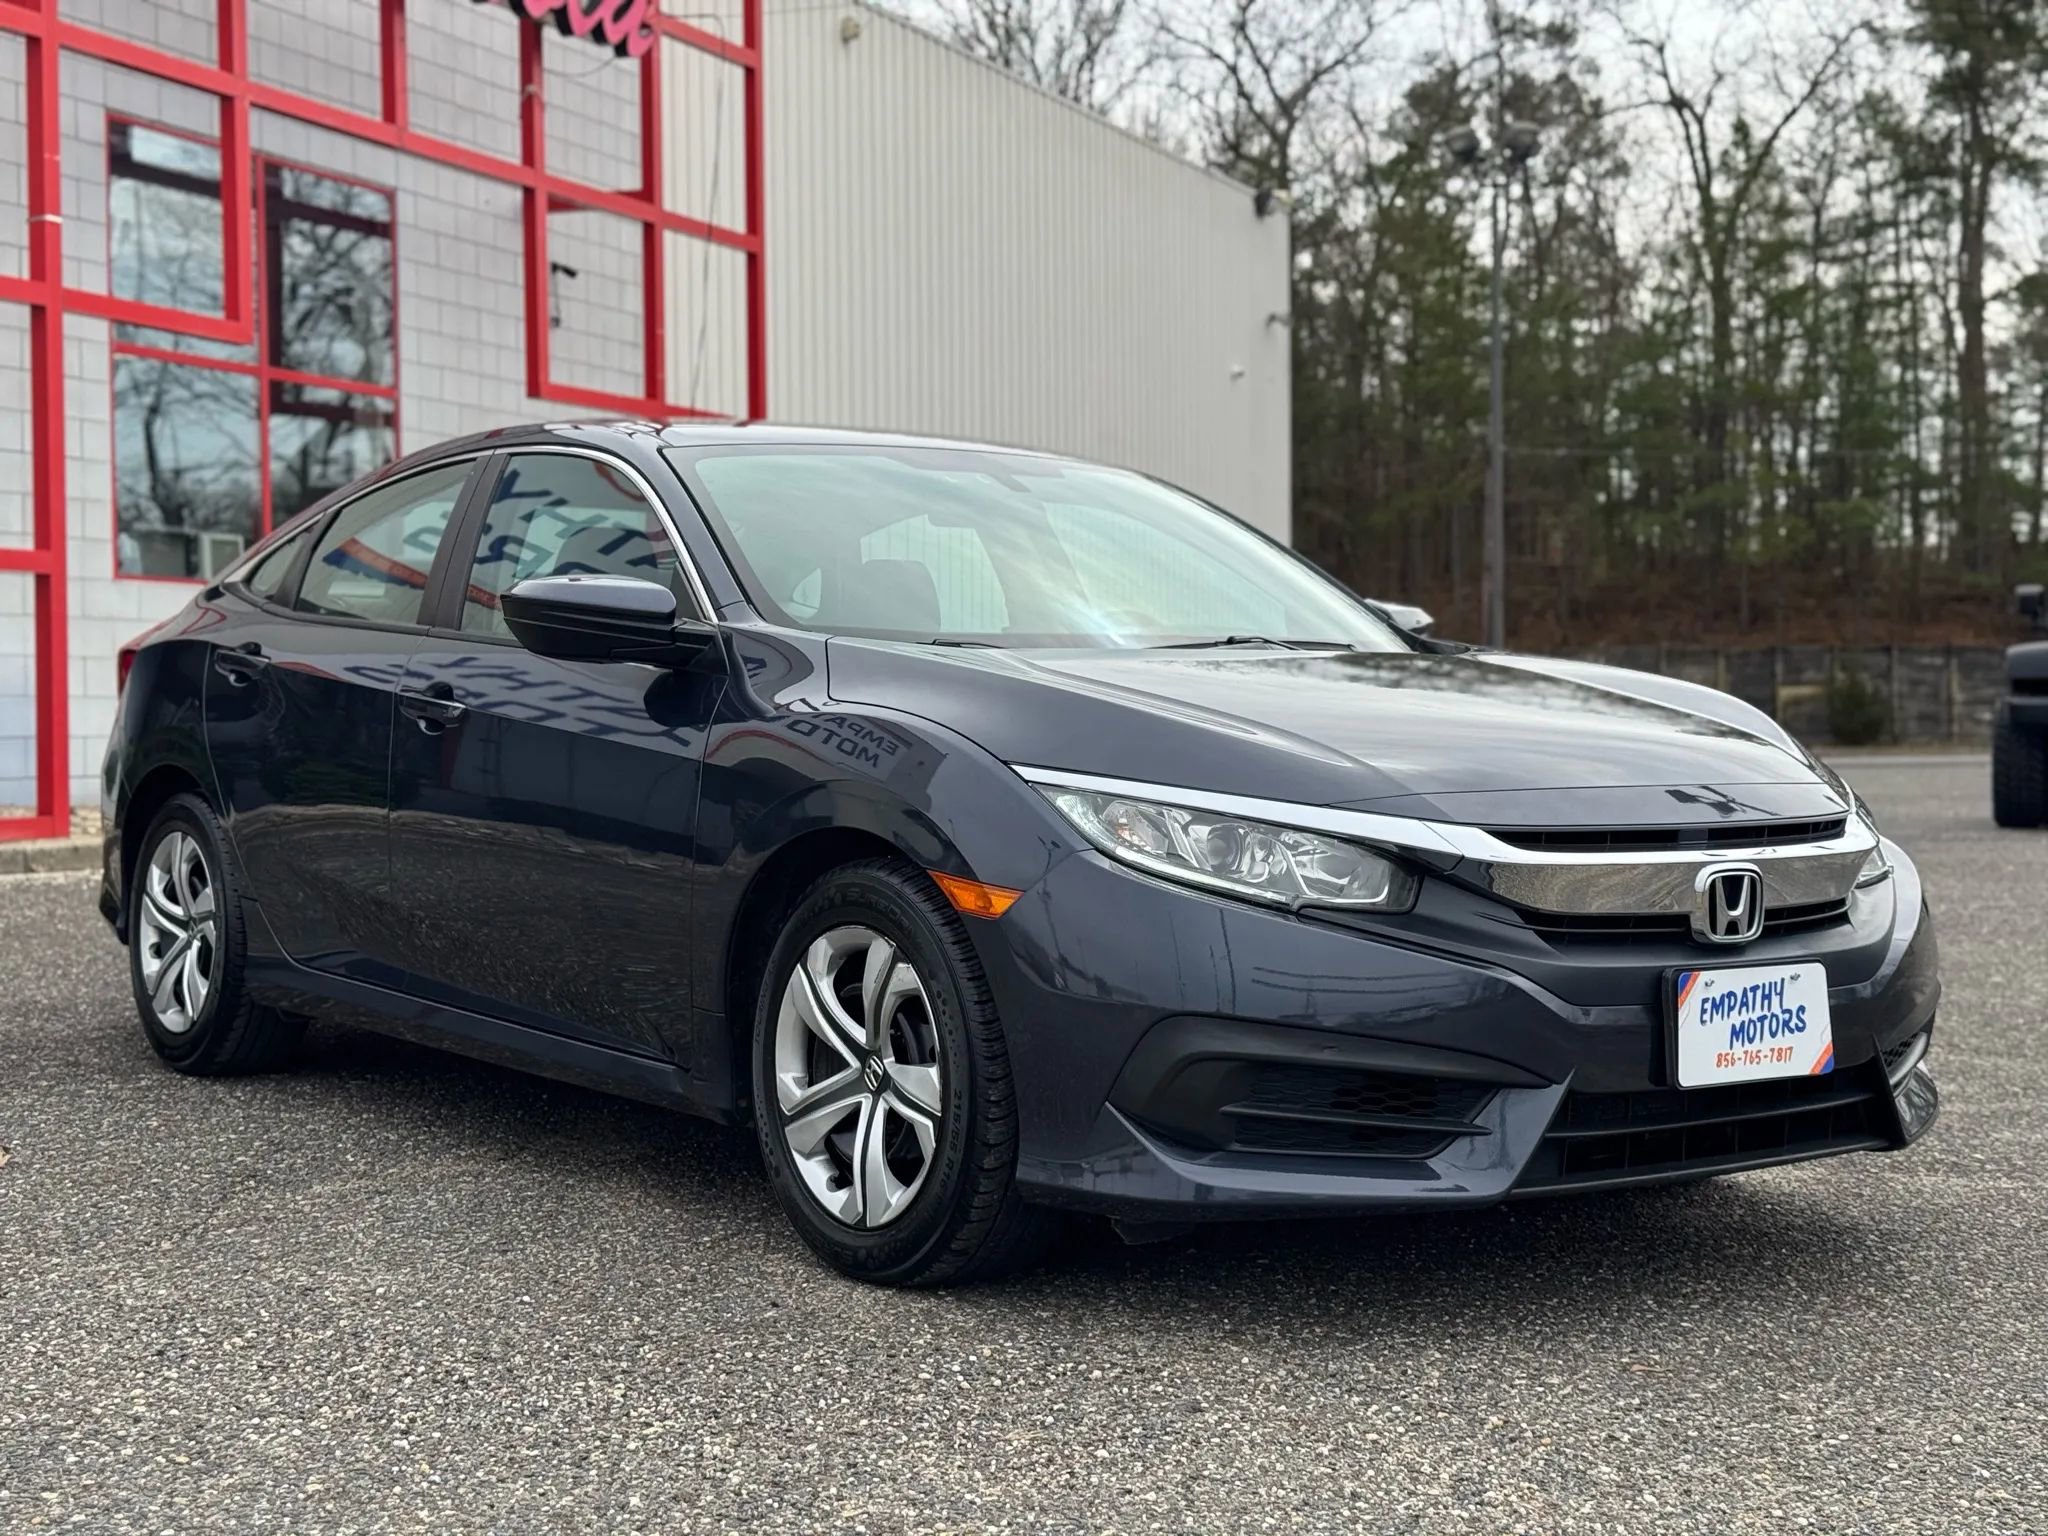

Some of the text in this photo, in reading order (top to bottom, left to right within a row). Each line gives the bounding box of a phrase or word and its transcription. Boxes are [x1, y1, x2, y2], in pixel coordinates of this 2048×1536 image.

[1700, 977, 1785, 1026] EMPATHY
[1730, 1005, 1807, 1050] MOTORS
[1716, 1046, 1794, 1068] 856-765-7817
